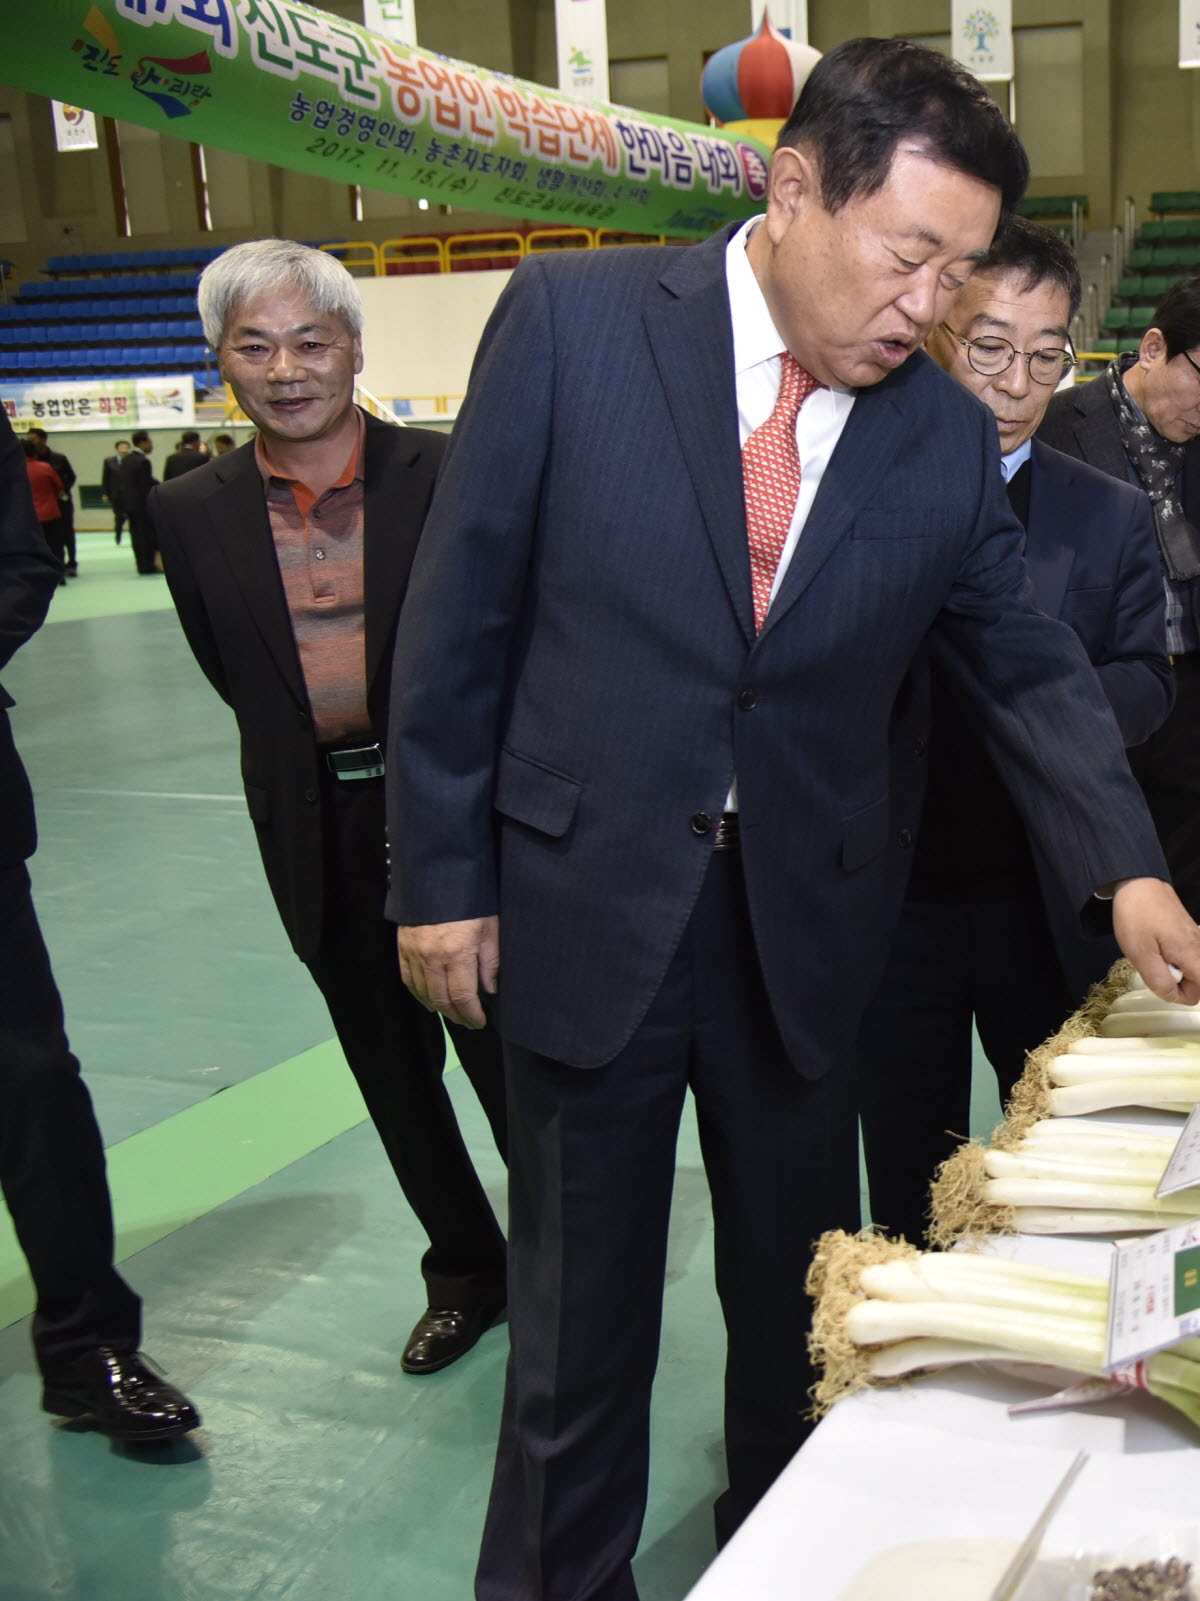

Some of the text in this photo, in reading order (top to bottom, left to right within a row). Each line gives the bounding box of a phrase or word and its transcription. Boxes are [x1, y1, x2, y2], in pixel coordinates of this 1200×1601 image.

[290, 92, 417, 154] 농업경영인회,
[381, 46, 494, 137] 농업인
[492, 85, 617, 169] 학습단체
[616, 121, 692, 184] 한마음
[692, 140, 740, 191] 대회
[305, 137, 365, 168] 2017.
[376, 158, 399, 178] 11.
[32, 399, 91, 417] 농업인은
